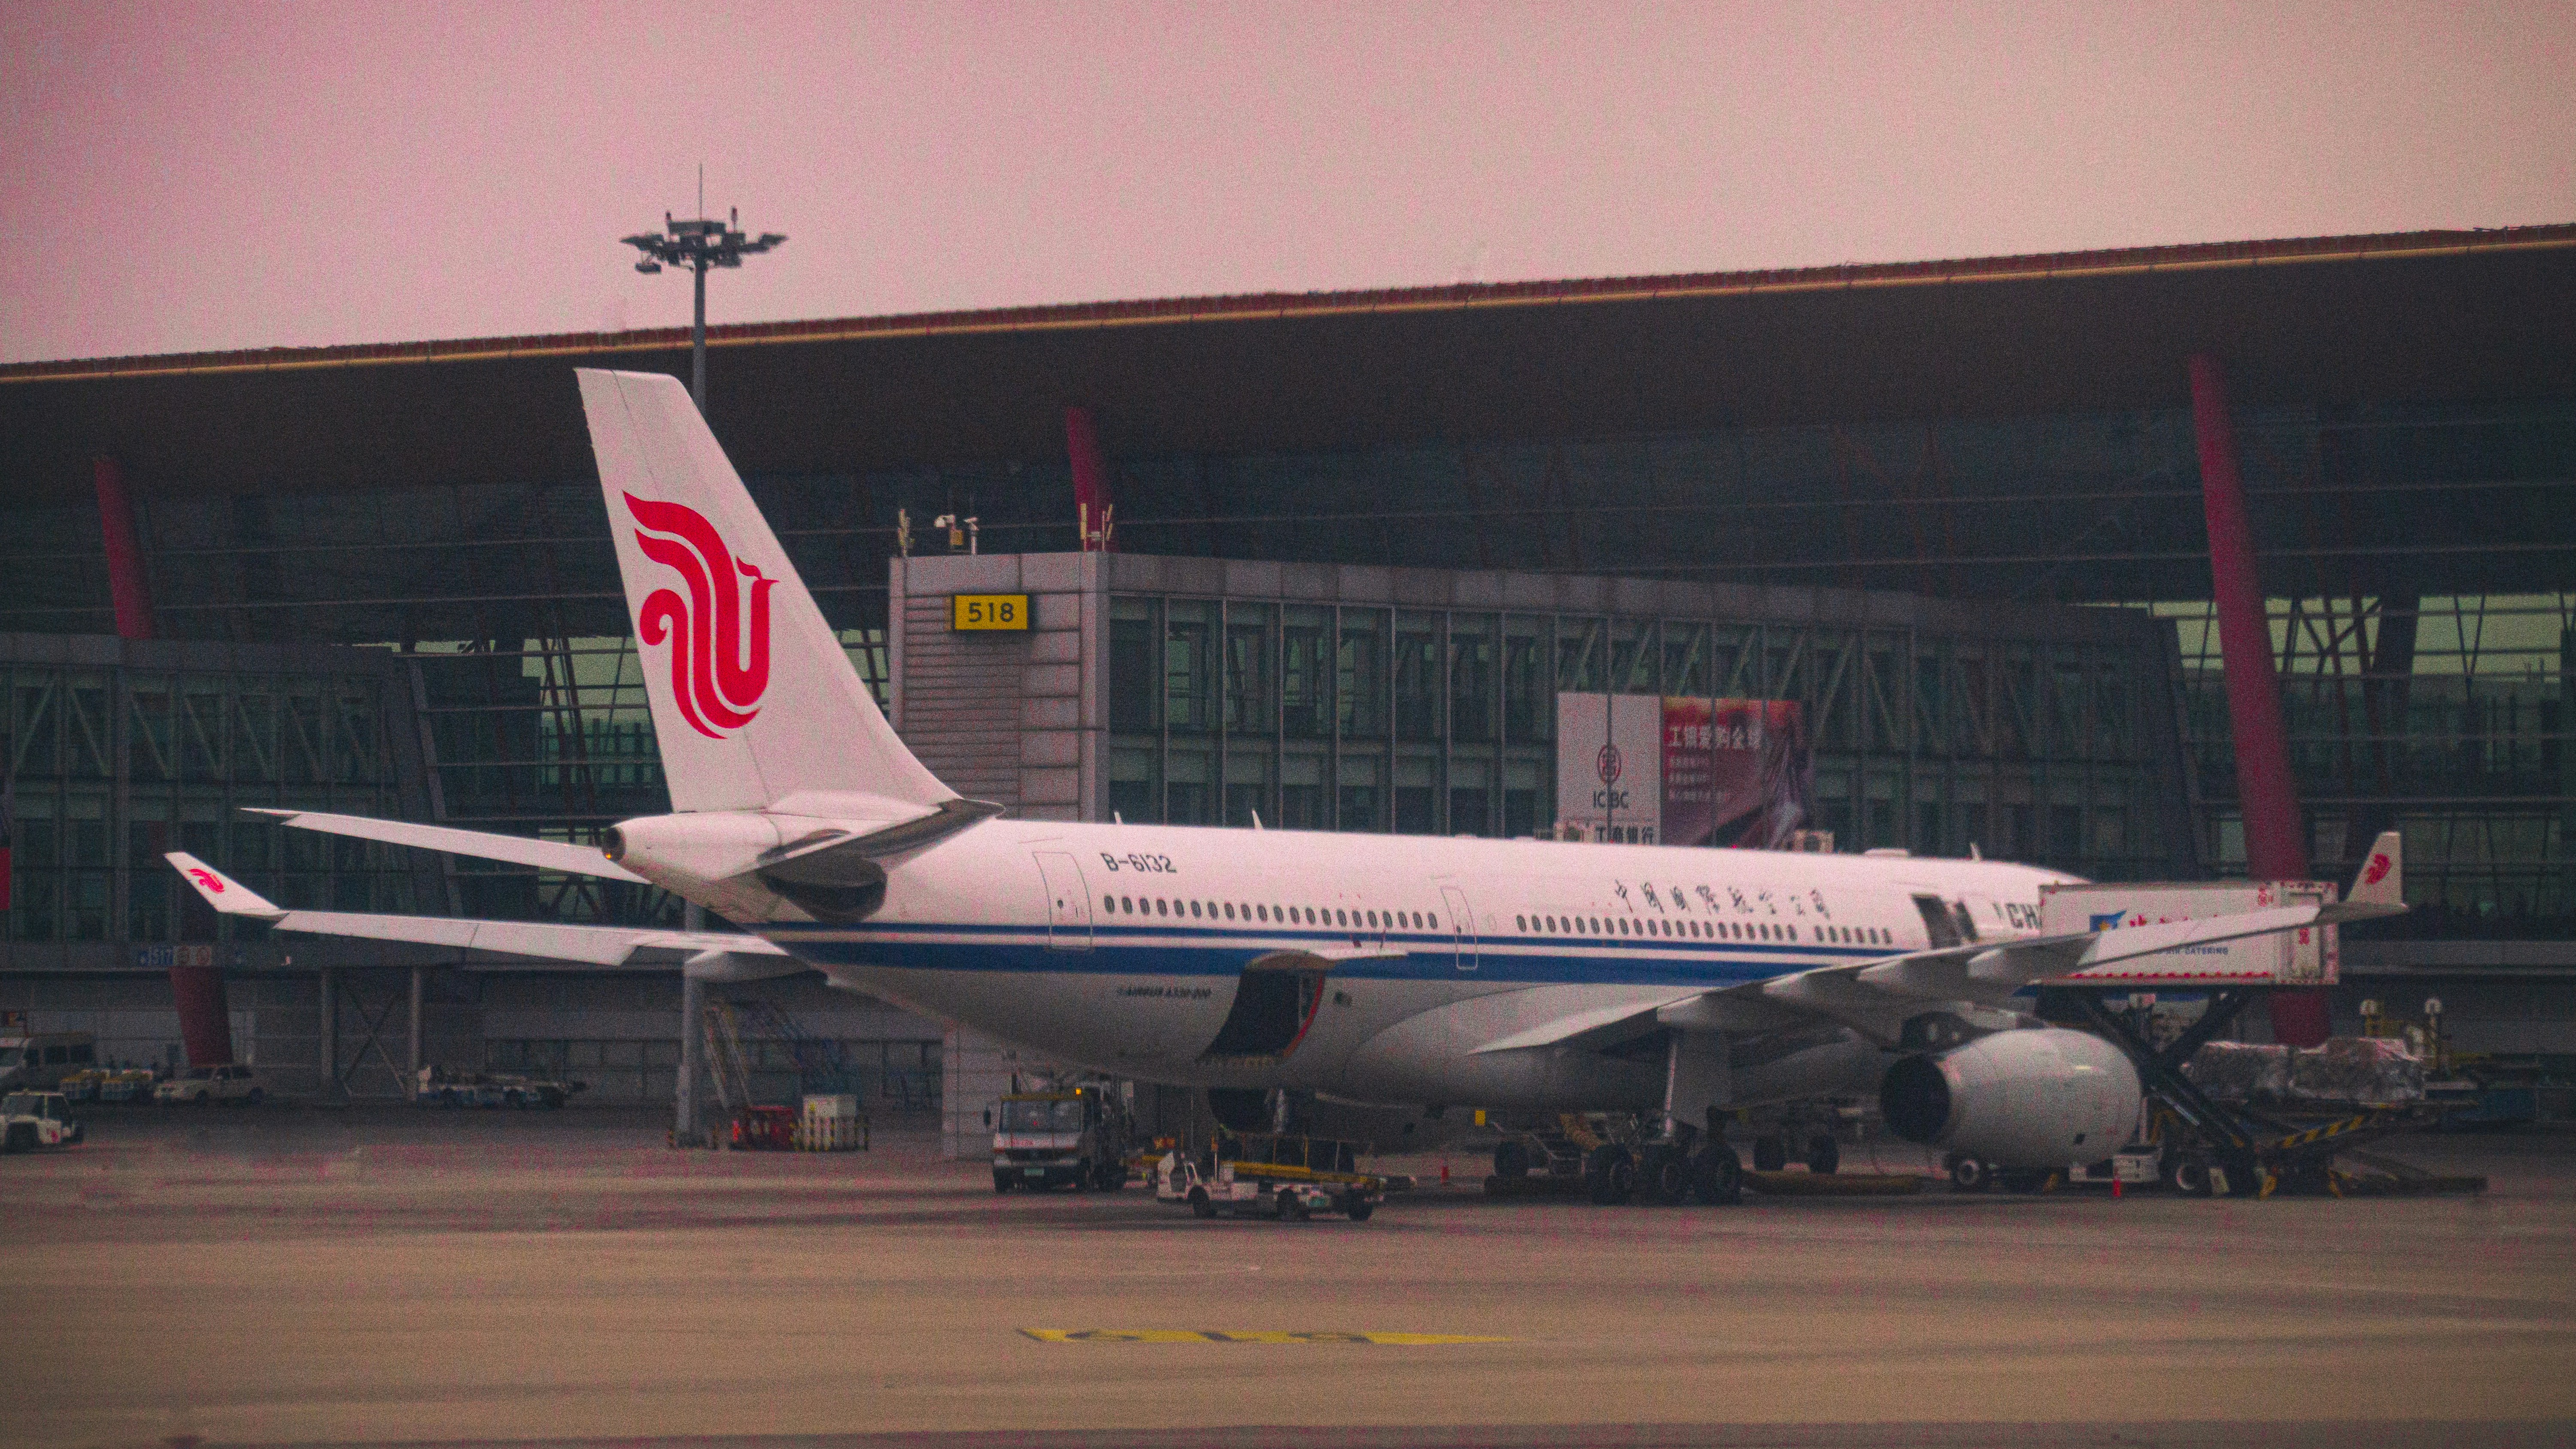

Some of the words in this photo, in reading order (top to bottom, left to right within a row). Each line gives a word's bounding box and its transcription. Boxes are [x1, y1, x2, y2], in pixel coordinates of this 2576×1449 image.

[969, 602, 1014, 622] 518
[1593, 791, 1628, 808] ICBC
[1100, 852, 1177, 873] B-6132
[2185, 947, 2229, 955] CATERING
